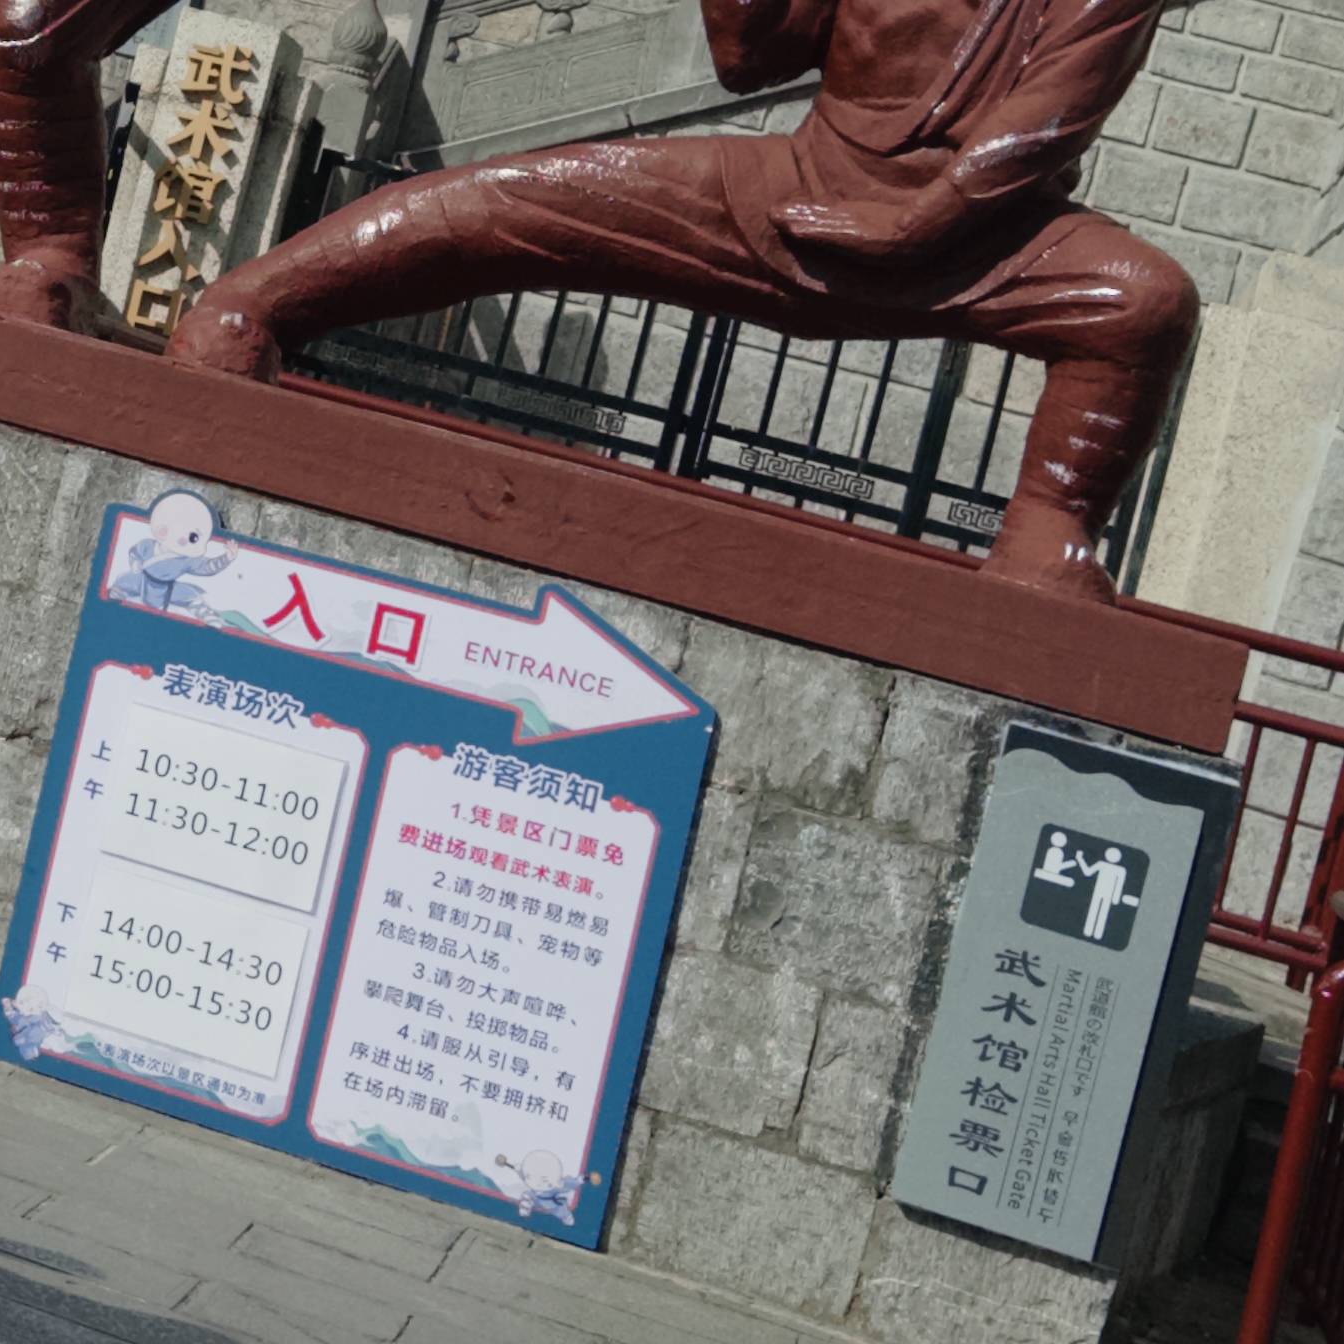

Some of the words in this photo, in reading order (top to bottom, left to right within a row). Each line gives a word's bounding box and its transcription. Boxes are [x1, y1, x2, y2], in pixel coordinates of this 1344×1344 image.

[124, 43, 254, 330] 武术馆入口
[263, 572, 426, 665] 入口
[163, 665, 304, 729] 表演场次
[464, 641, 615, 699] ENTRANCE
[135, 748, 320, 821] 10:30-11:00
[453, 745, 601, 814] 游客须知
[125, 792, 309, 866] 11:30-12:00
[450, 803, 625, 867] 1.凭景区门票免
[398, 823, 604, 901] 费进场观看武术表演。
[99, 910, 283, 986] 14:00-14:30
[375, 919, 510, 975] 危险物品入场。
[89, 954, 273, 1031] 15:00-15:30
[1052, 968, 1083, 1032] Martial
[948, 948, 1047, 1196] 武术馆检票口
[1042, 1033, 1066, 1069] Arts
[343, 1071, 460, 1123] 在场内滞留。
[1033, 1072, 1056, 1109] Hall
[1019, 1111, 1047, 1166] Ticket
[1008, 1168, 1032, 1210] Gate
